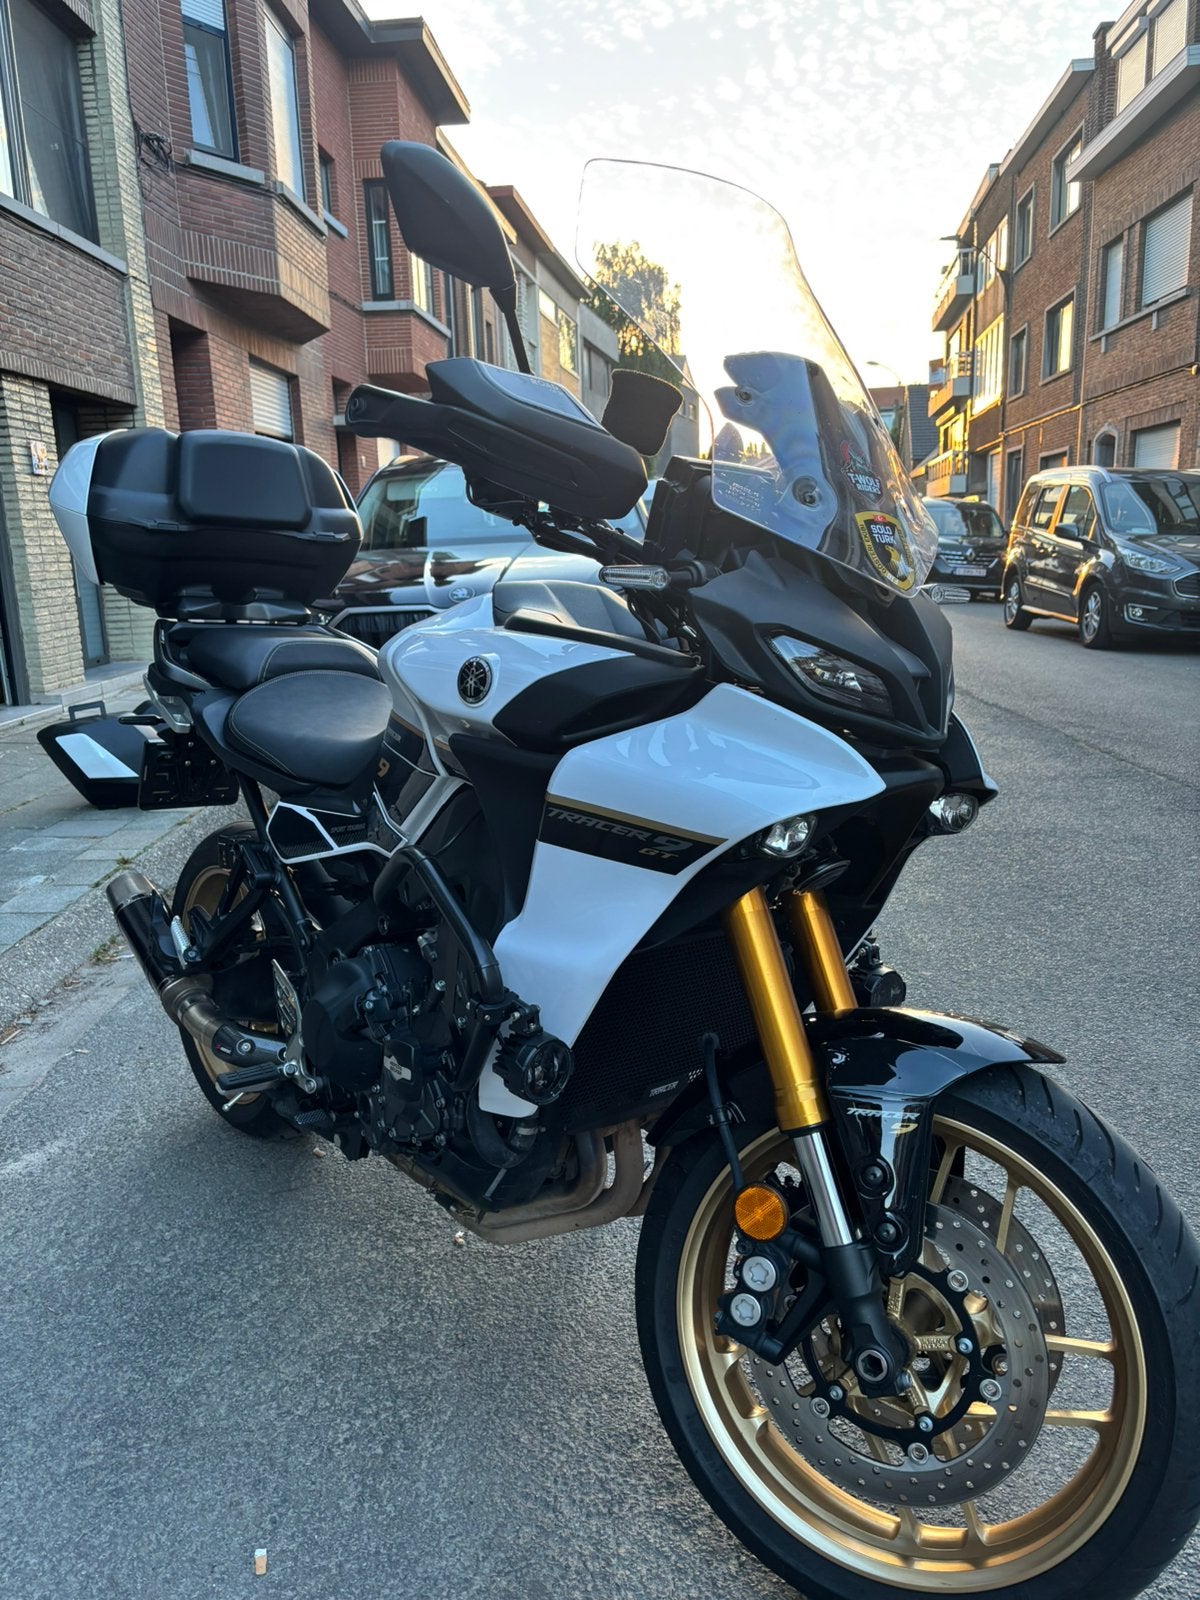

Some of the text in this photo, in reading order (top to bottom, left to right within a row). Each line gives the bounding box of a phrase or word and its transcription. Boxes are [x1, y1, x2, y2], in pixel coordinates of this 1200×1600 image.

[847, 472, 881, 489] T-WOLF
[856, 483, 882, 495] RIDERS
[870, 524, 893, 535] SOLO
[547, 807, 695, 852] TRACER 9
[637, 848, 680, 859] GT
[846, 1107, 921, 1120] TRACER
